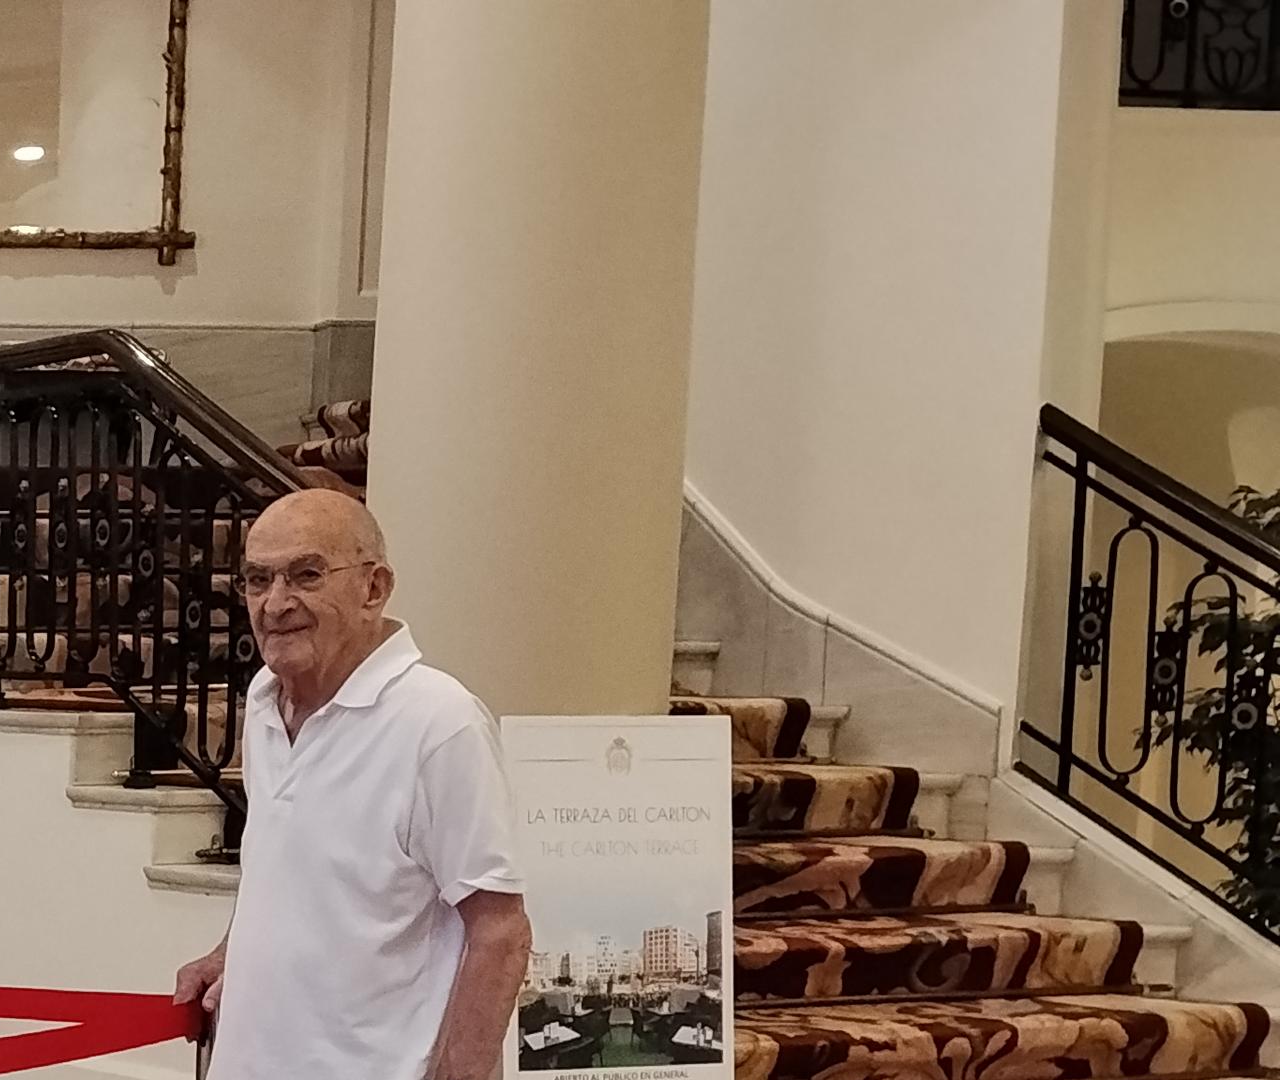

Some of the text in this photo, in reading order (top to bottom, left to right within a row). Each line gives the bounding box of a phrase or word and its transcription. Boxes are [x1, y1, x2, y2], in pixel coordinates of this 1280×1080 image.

[527, 806, 711, 824] LA TERRAZA DEL CARLTON
[539, 841, 564, 858] THE
[571, 840, 638, 857] CARLTON
[640, 1071, 651, 1080] EN
[653, 1069, 689, 1080] GENERAL
